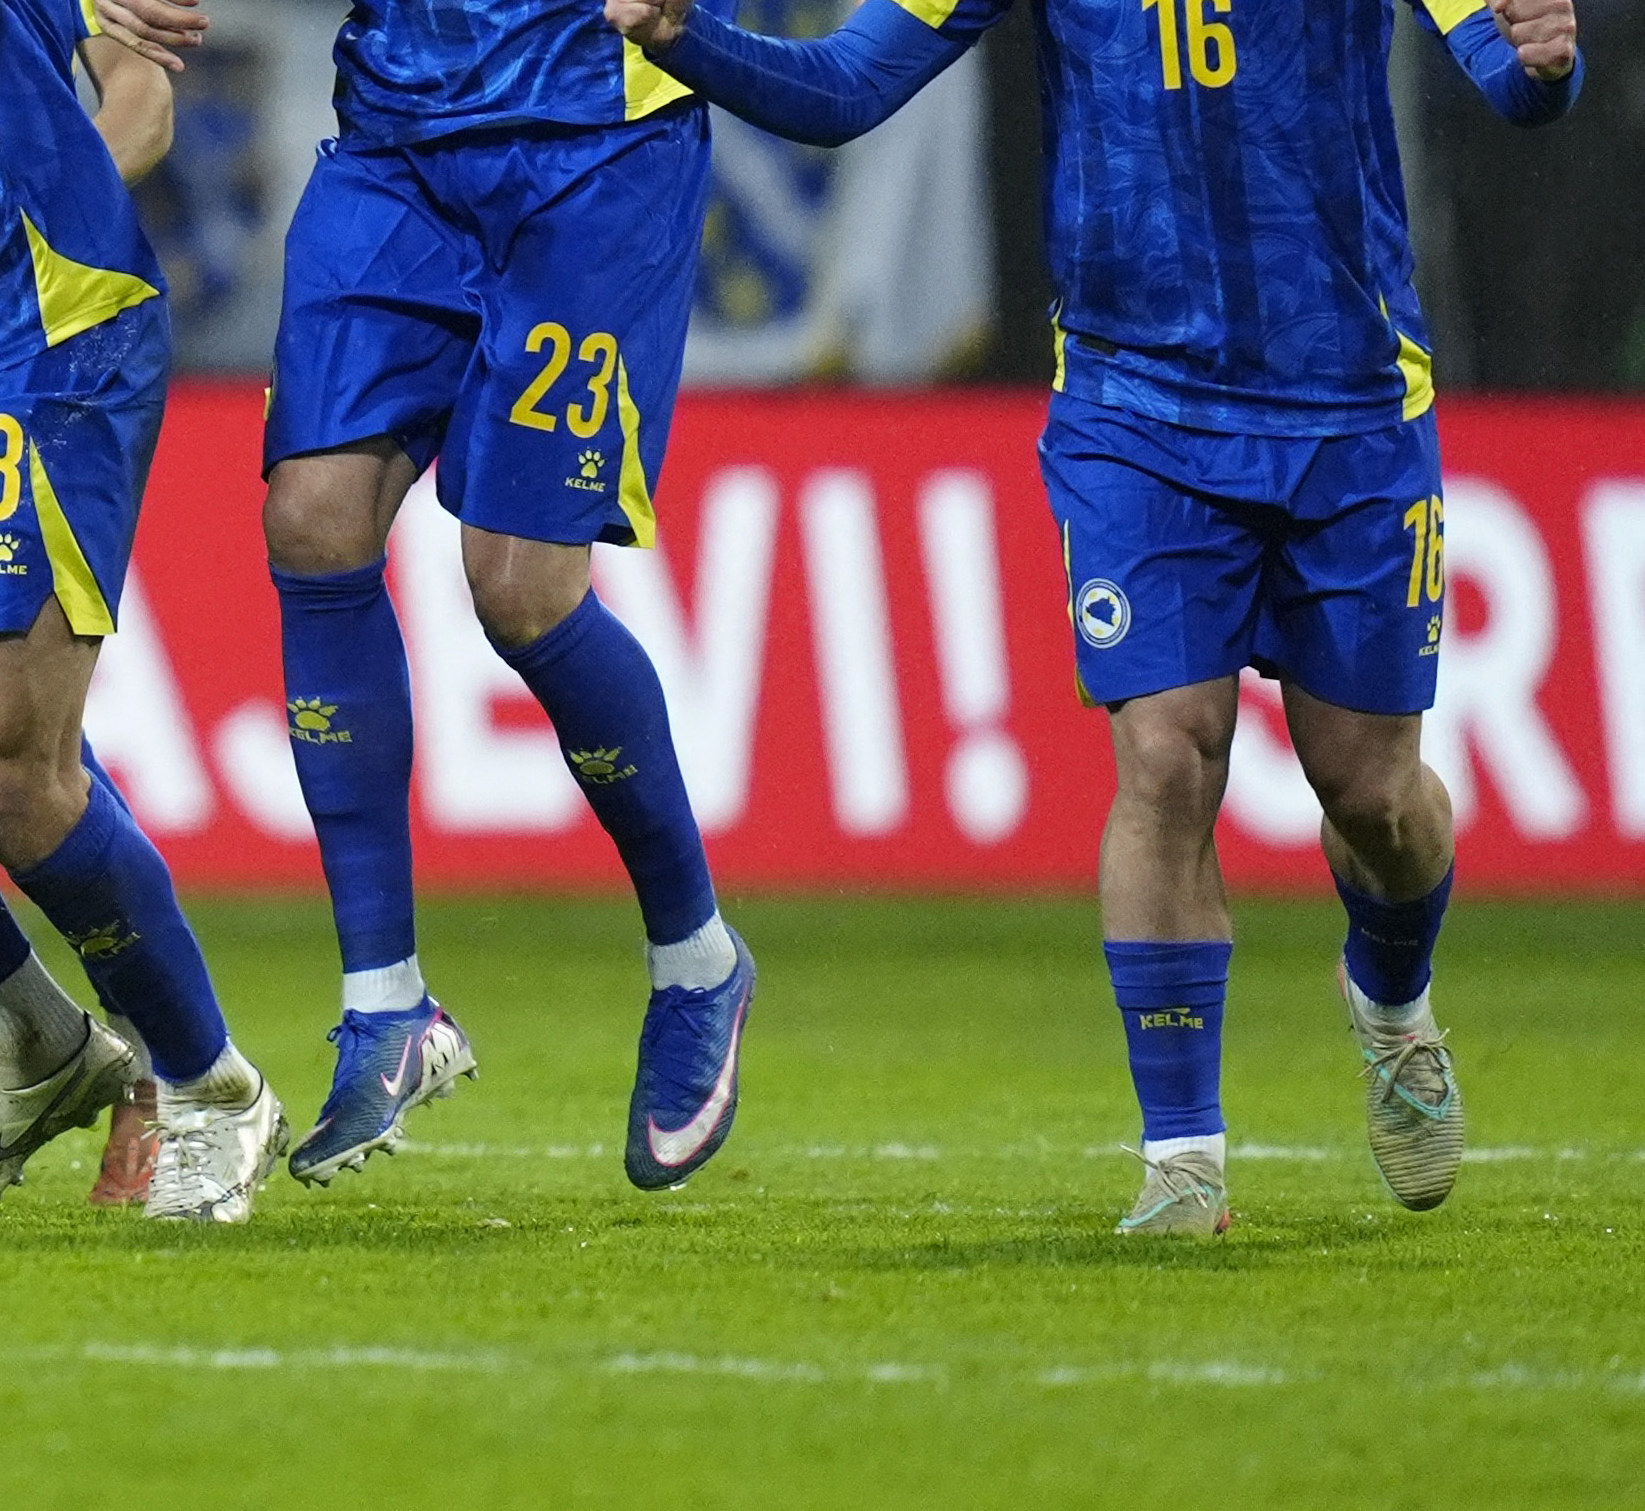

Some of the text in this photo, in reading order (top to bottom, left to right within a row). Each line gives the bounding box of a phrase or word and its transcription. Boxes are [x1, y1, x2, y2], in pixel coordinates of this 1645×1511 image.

[509, 321, 619, 439] 23
[564, 476, 608, 493] KELME
[1403, 493, 1444, 608] 16
[1140, 1012, 1204, 1031] KELME
